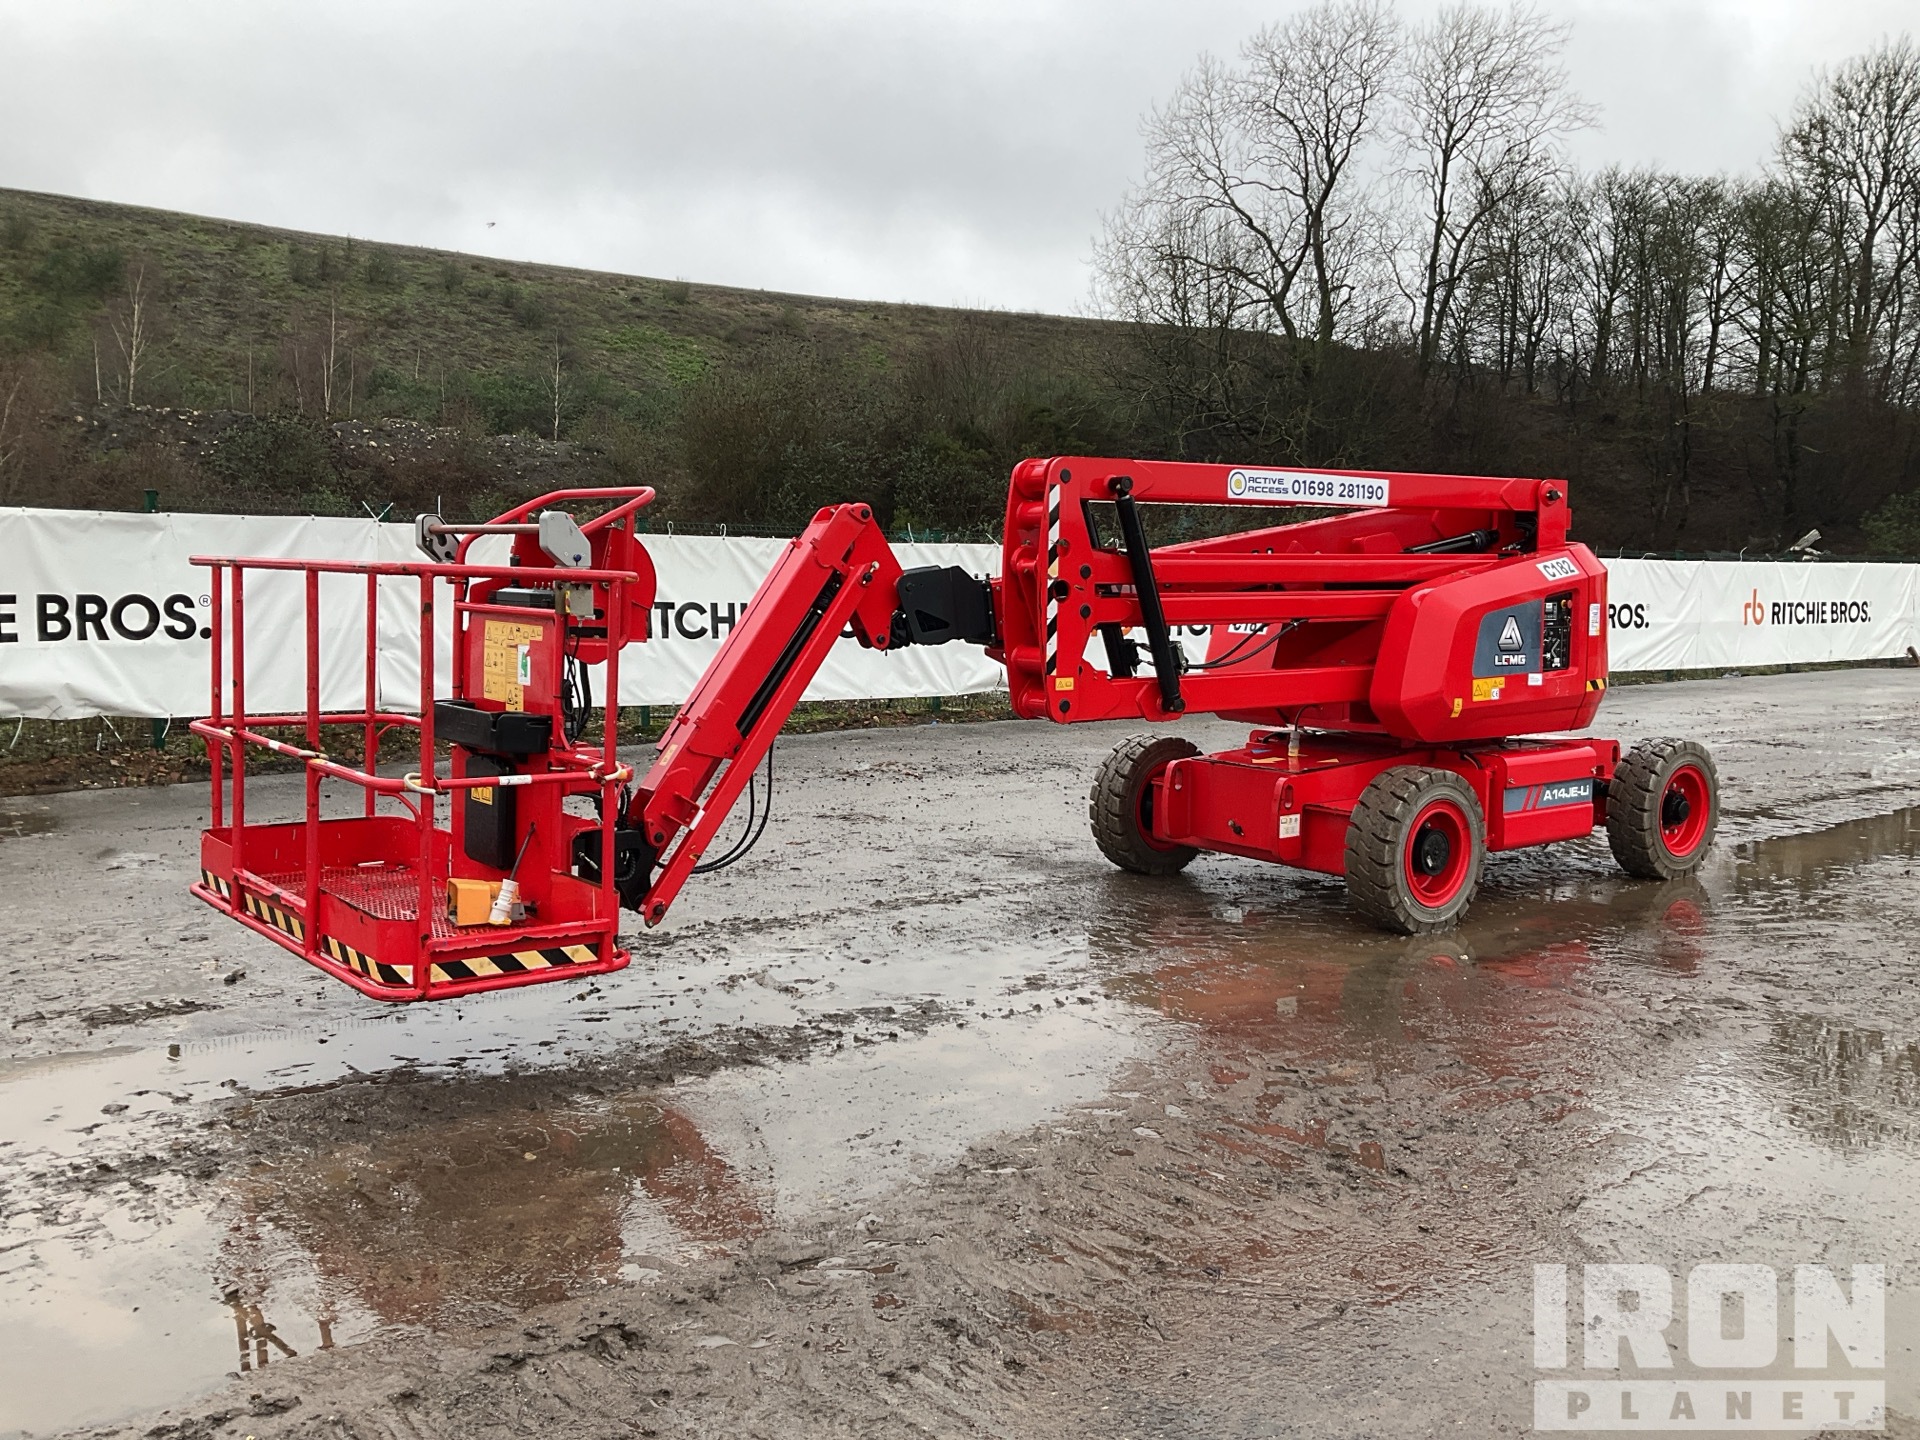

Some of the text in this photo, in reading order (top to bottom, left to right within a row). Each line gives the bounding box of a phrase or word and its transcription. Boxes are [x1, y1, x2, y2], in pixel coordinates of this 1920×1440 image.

[1248, 476, 1285, 486] ACTIVE
[1248, 486, 1289, 495] ACCESS
[1292, 479, 1384, 501] 01698 281190
[1543, 559, 1576, 578] C182
[1771, 602, 1828, 625] RITCHIE
